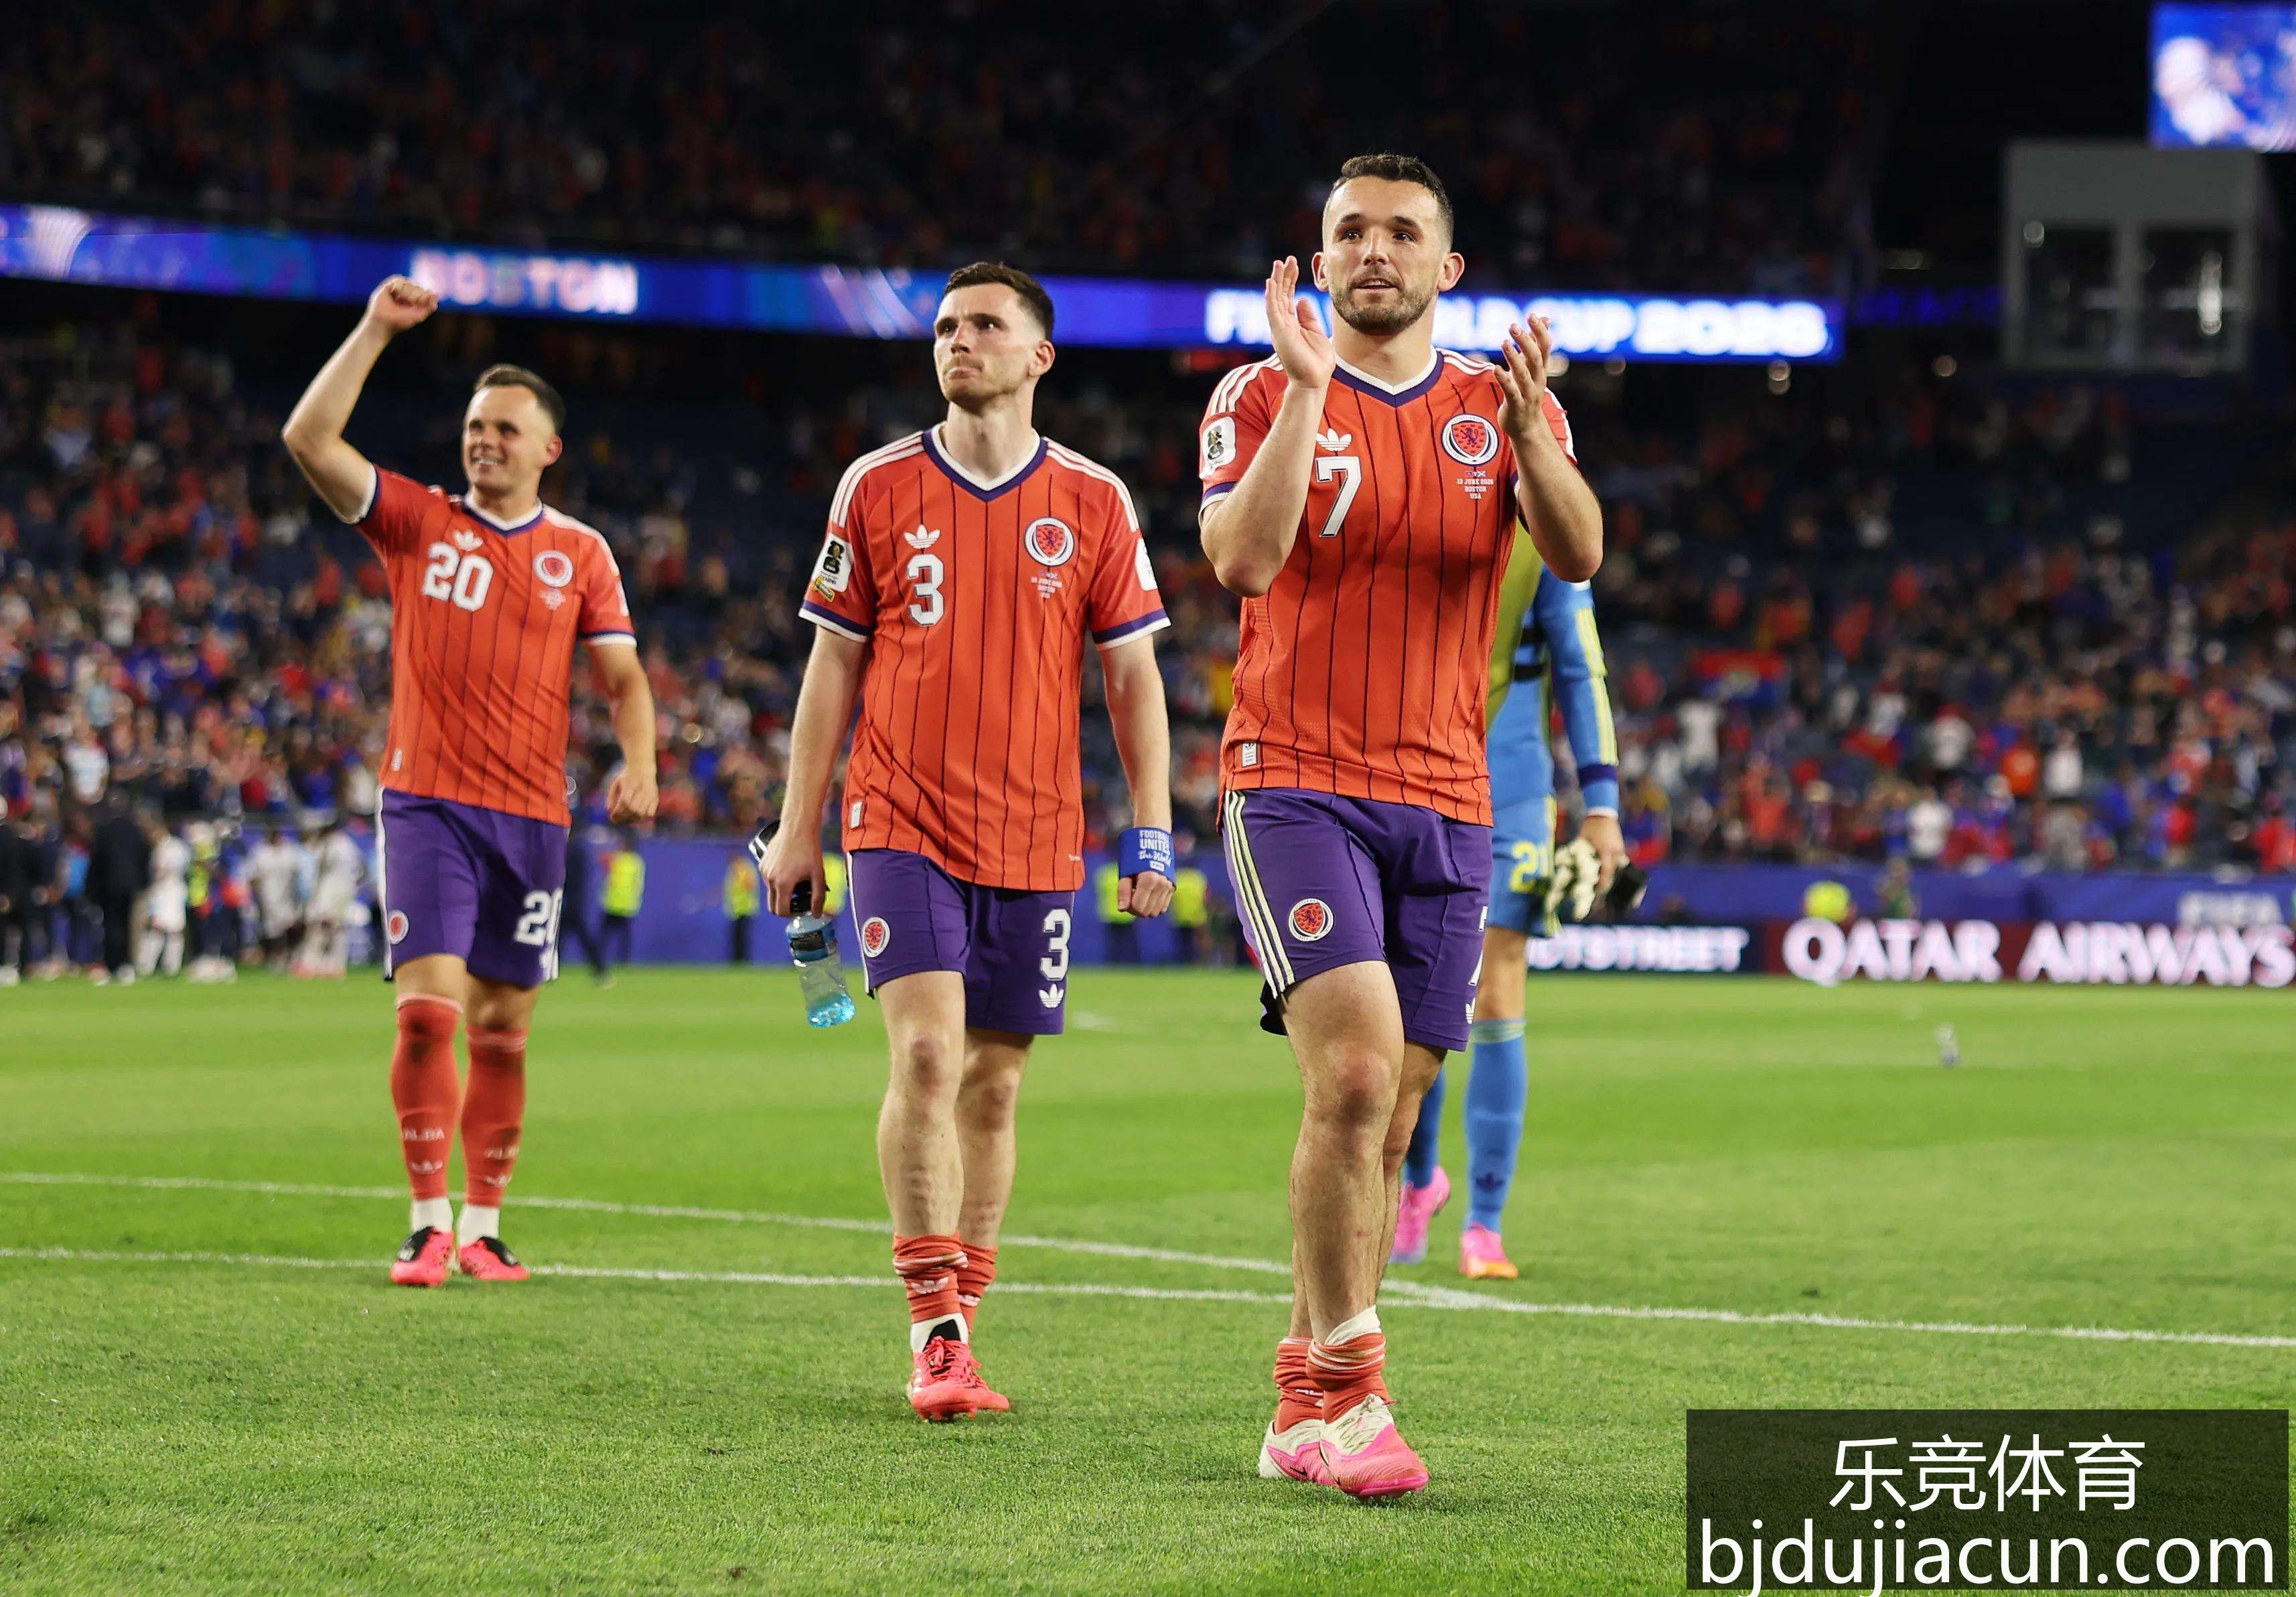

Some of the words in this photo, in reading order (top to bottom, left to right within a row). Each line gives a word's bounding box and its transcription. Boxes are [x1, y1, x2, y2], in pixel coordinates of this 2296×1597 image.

[411, 247, 638, 314] BOSTON
[1633, 299, 1829, 357] 2026
[1315, 456, 1361, 537] 7
[421, 541, 494, 612] 20
[907, 554, 944, 626] 3
[1039, 908, 1071, 981] 3
[1784, 917, 2003, 987] QATAR
[2019, 921, 2296, 988] AIRWAYS
